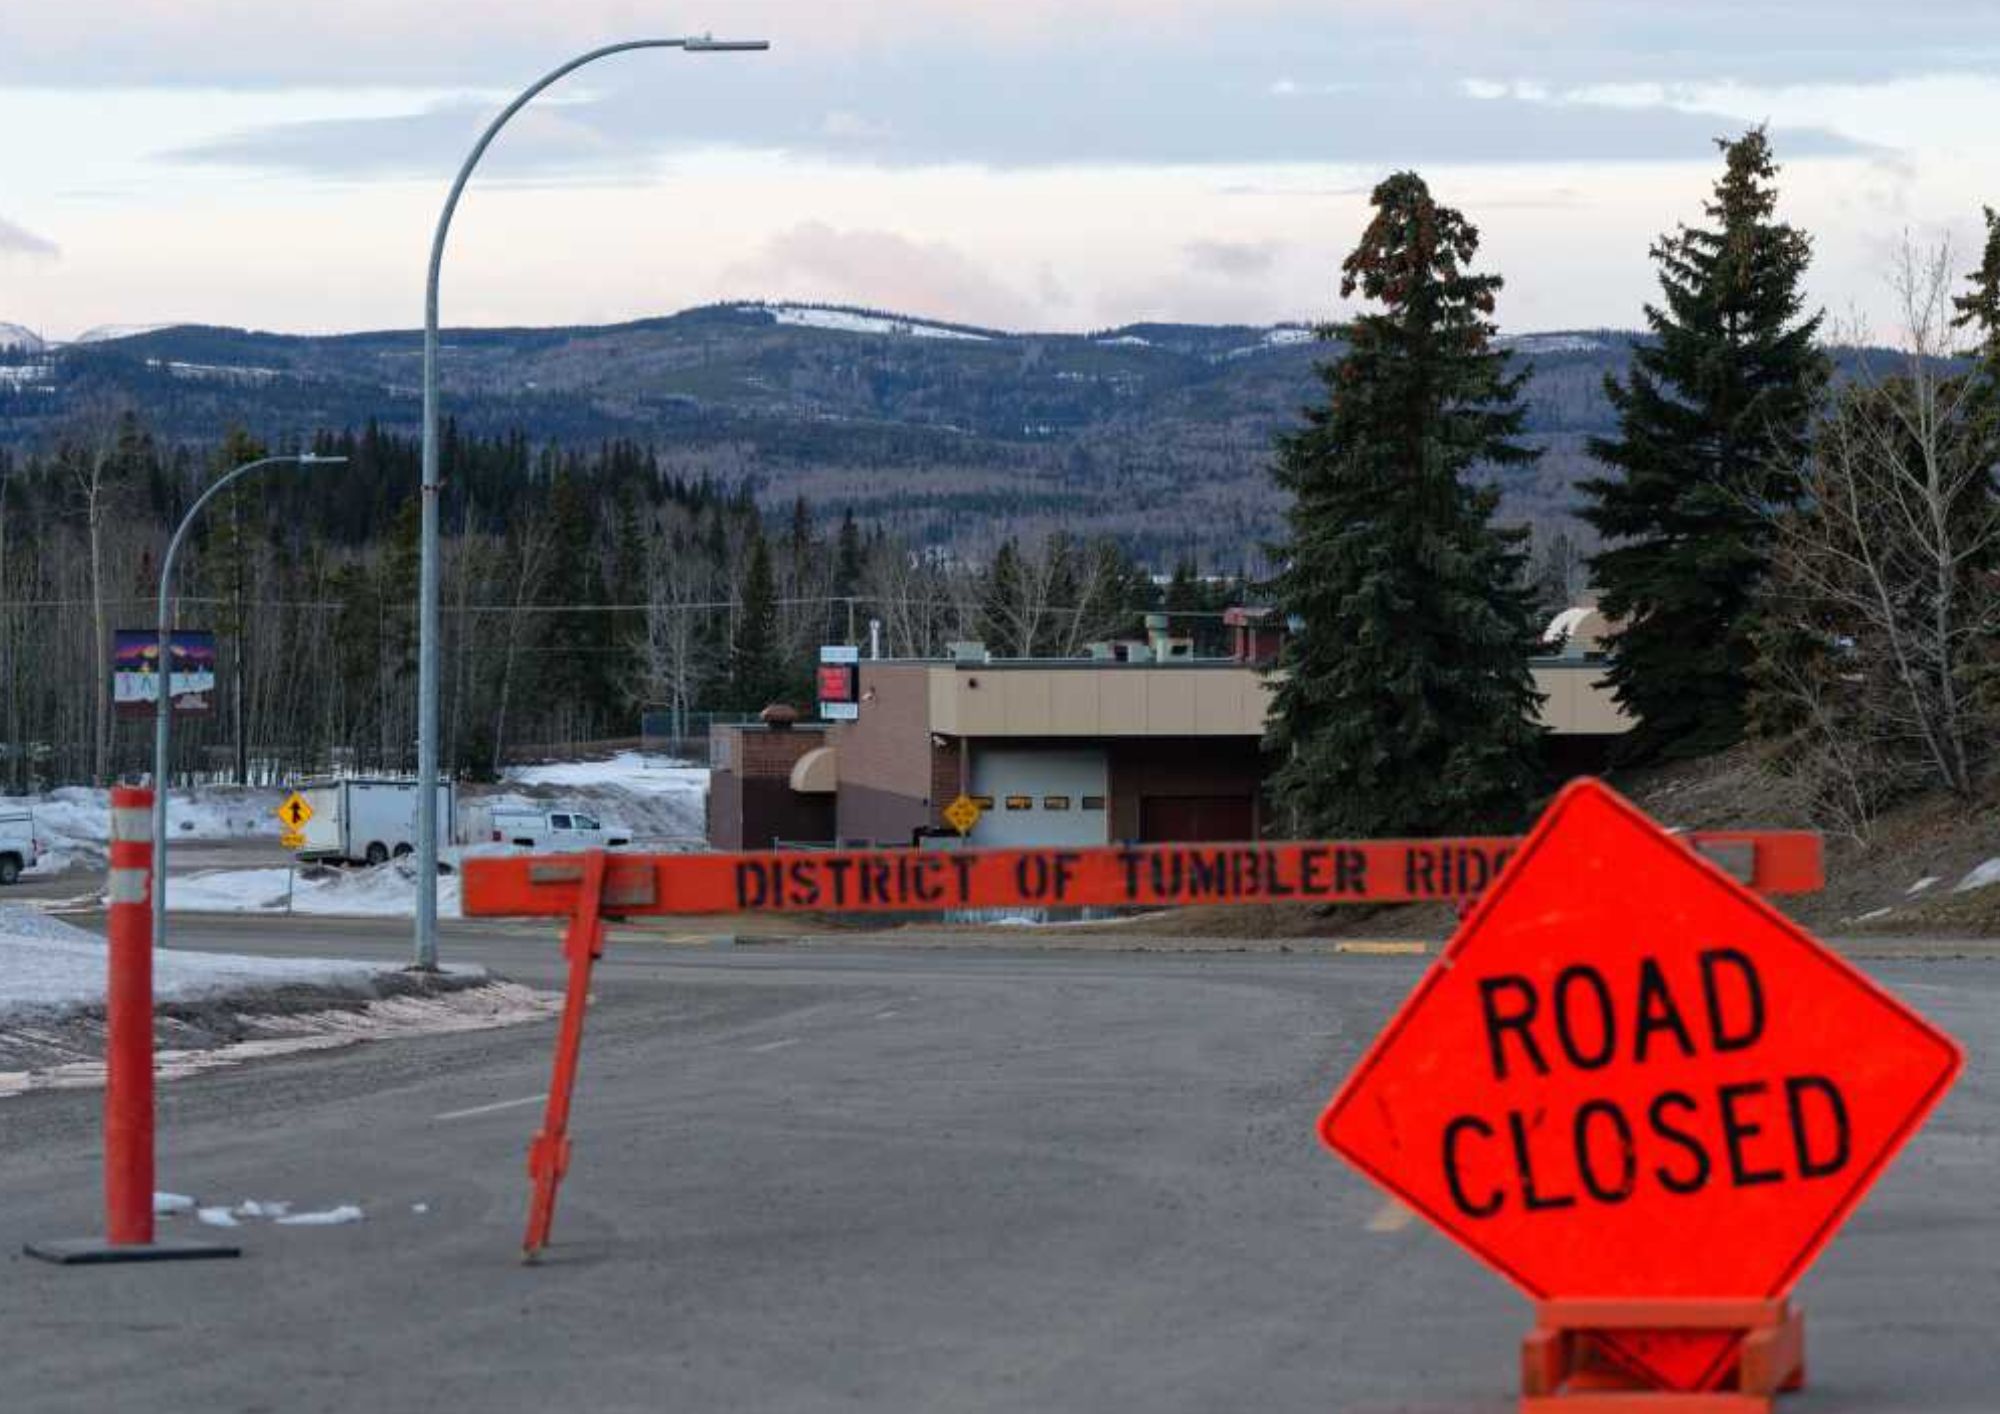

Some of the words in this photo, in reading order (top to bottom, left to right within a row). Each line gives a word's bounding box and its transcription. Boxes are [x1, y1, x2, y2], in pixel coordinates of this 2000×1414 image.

[736, 855, 979, 908] DISTRICT
[1016, 853, 1083, 899] OF
[1117, 848, 1368, 896] TUMBLER
[1479, 947, 1766, 1080] ROAD
[1442, 1075, 1850, 1218] CLOSED
